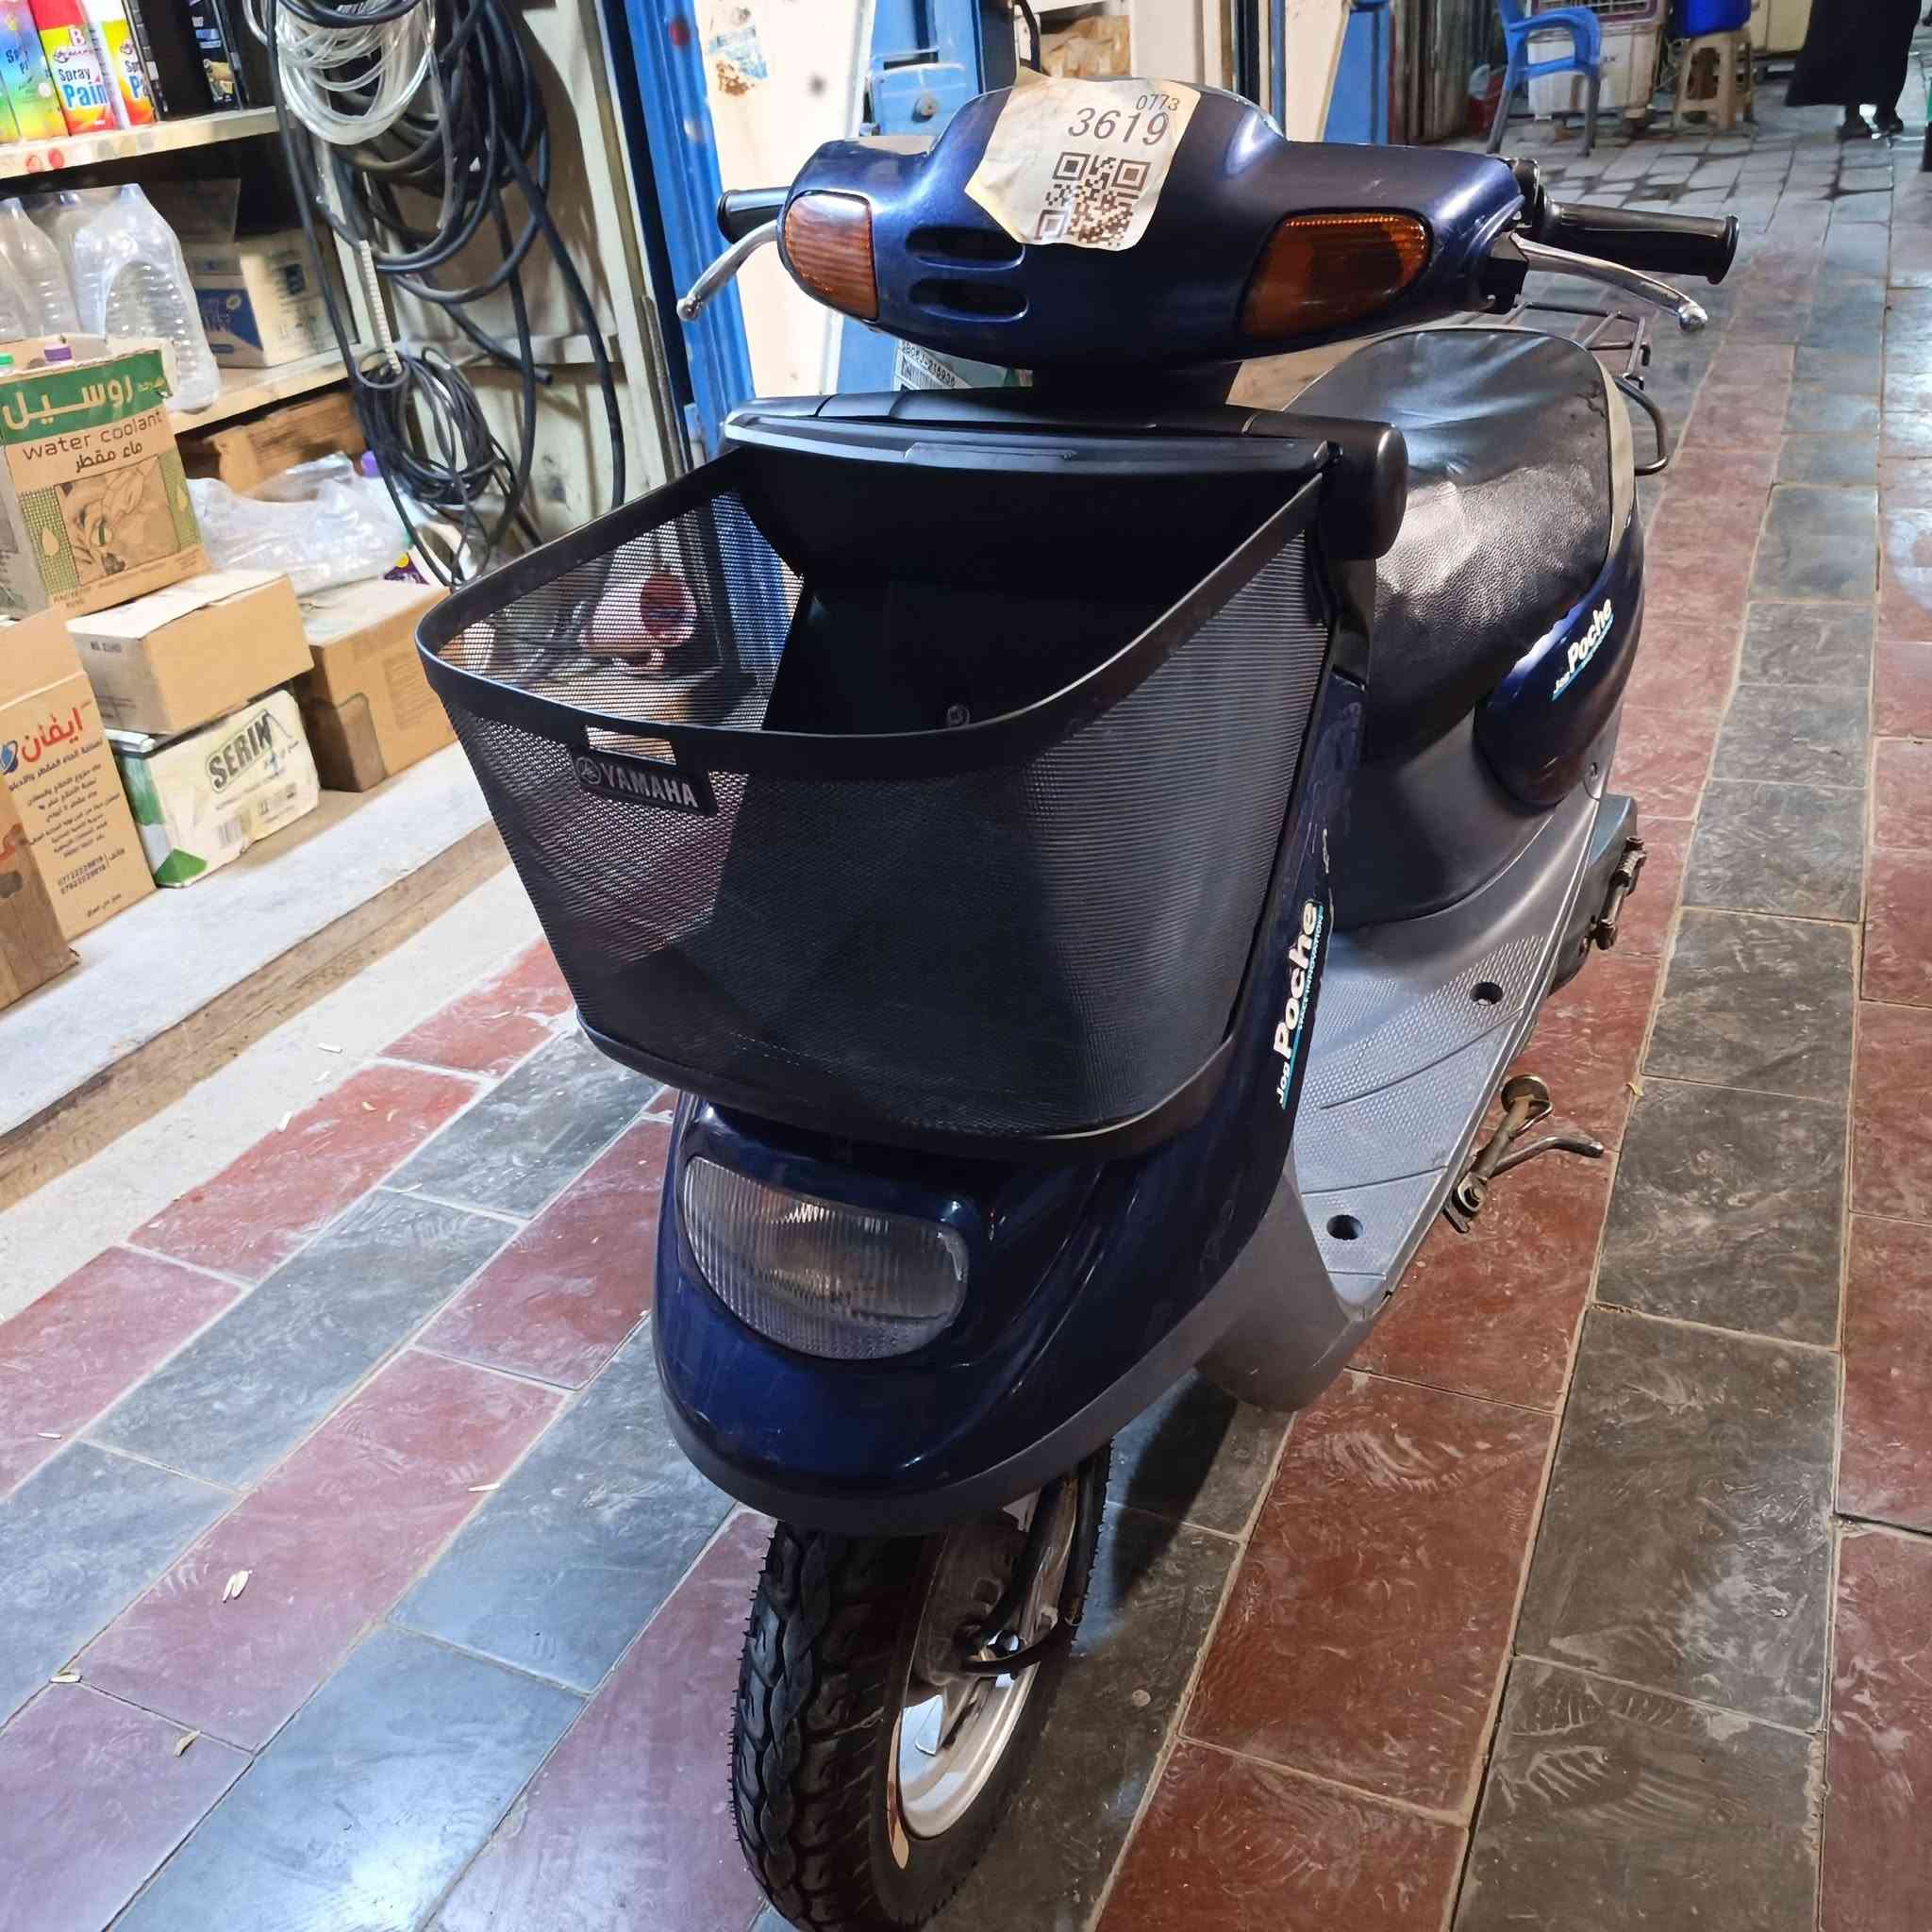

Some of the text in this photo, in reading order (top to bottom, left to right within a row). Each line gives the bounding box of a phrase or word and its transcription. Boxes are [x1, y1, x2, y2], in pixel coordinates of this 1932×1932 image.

[58, 66, 92, 83] Spray
[61, 83, 109, 108] Pain
[1135, 93, 1181, 111] 0773
[1067, 107, 1171, 146] 3619
[2, 375, 134, 430] روسيل
[22, 410, 163, 461] water coolant
[75, 441, 143, 474] ماء مقطر
[1567, 598, 1612, 674] Poche
[599, 761, 700, 808] YAMAHA
[1274, 902, 1318, 1105] Jog Poche
